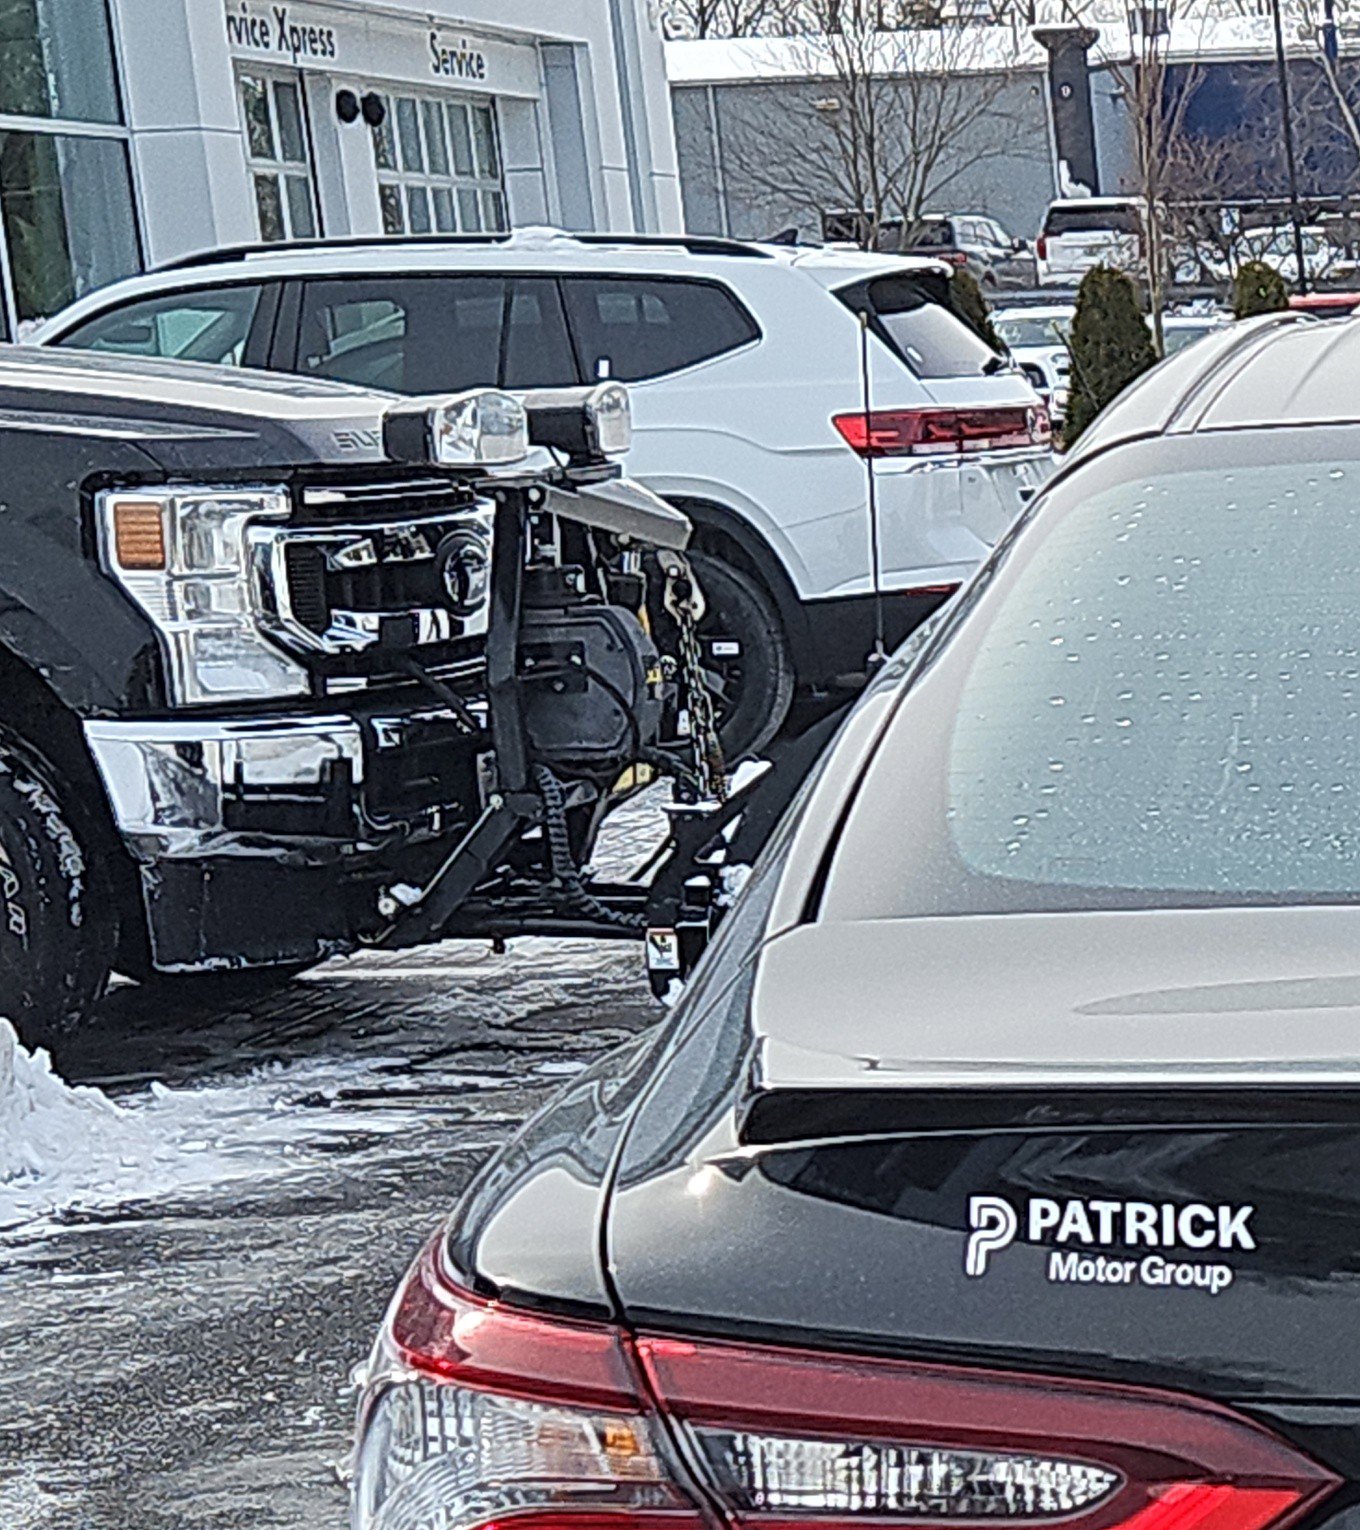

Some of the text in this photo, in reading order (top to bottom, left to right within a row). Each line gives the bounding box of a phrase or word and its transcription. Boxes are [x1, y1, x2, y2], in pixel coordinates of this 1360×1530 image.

[272, 6, 336, 64] Xpress
[429, 32, 486, 80] Service
[1028, 1198, 1257, 1250] PATRICK
[1049, 1251, 1233, 1294] Motor Group
